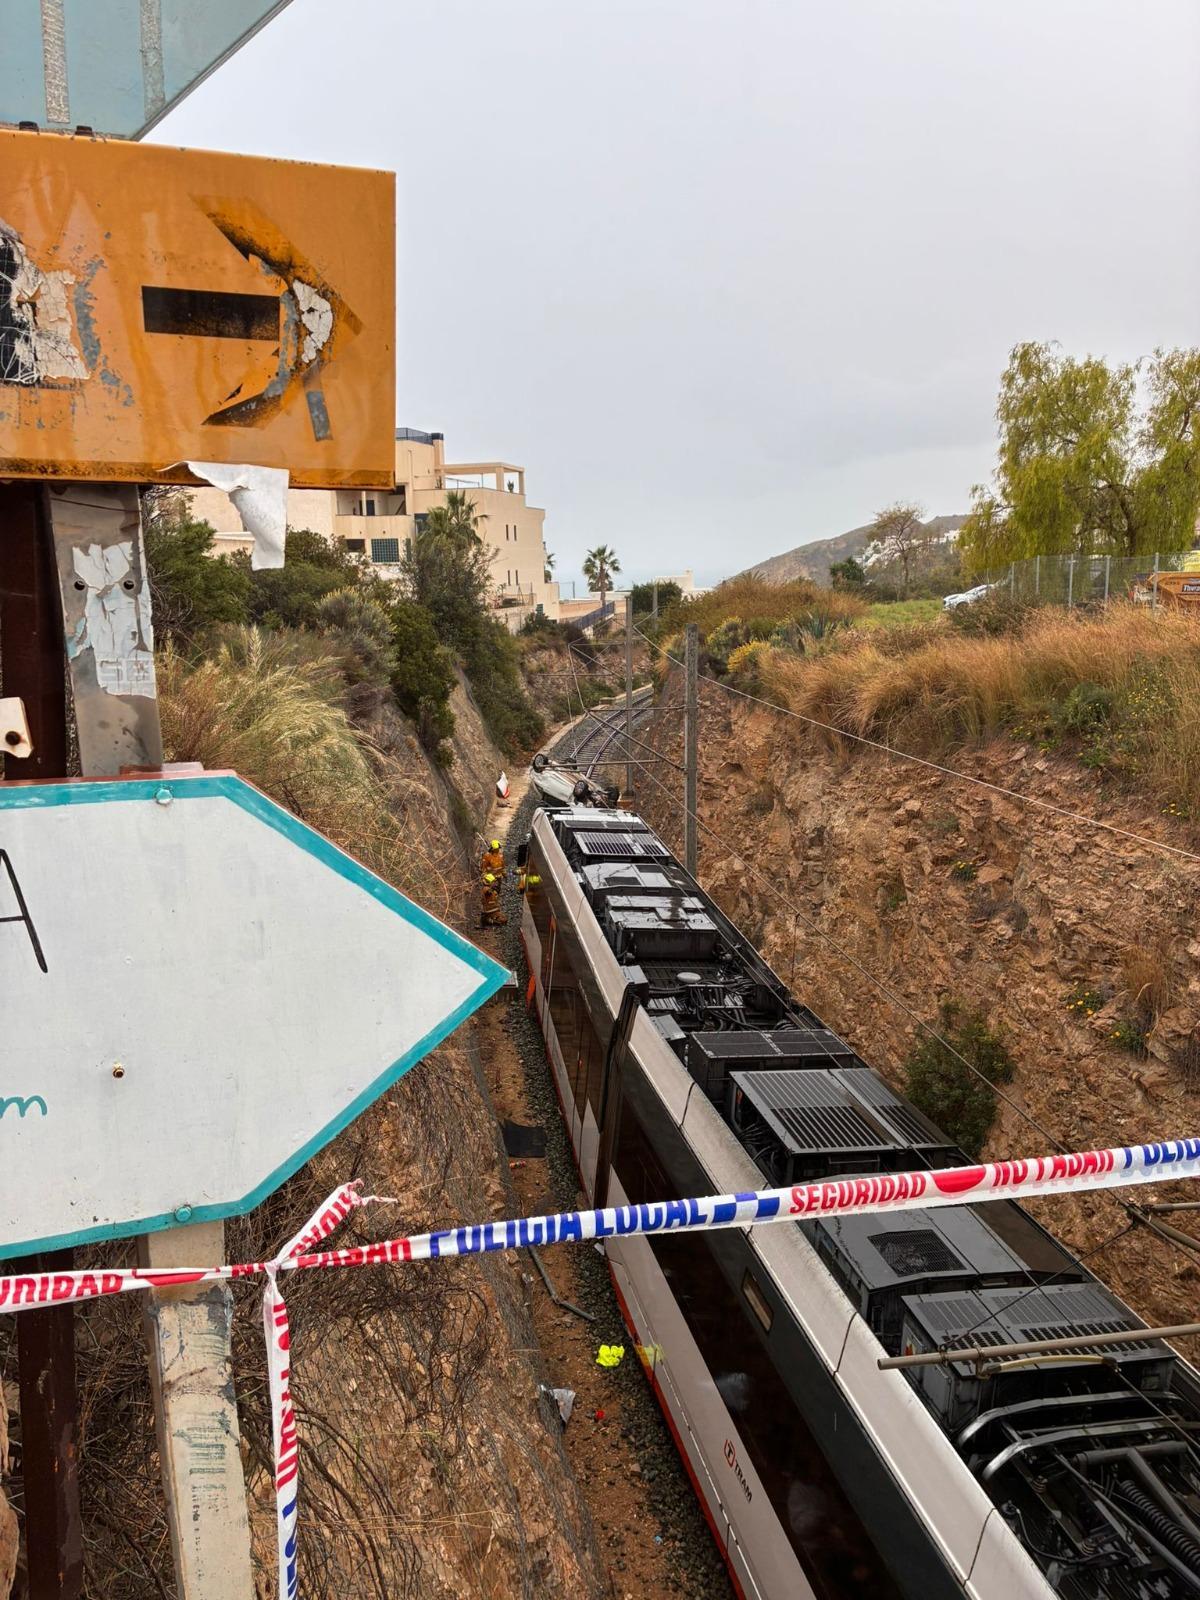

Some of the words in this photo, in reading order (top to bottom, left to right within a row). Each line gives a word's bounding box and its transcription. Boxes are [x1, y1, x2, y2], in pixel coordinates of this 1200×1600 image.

[595, 1198, 706, 1236] LOCAL
[789, 1171, 927, 1214] SEGURIDAD
[734, 1459, 753, 1504] TRAM
